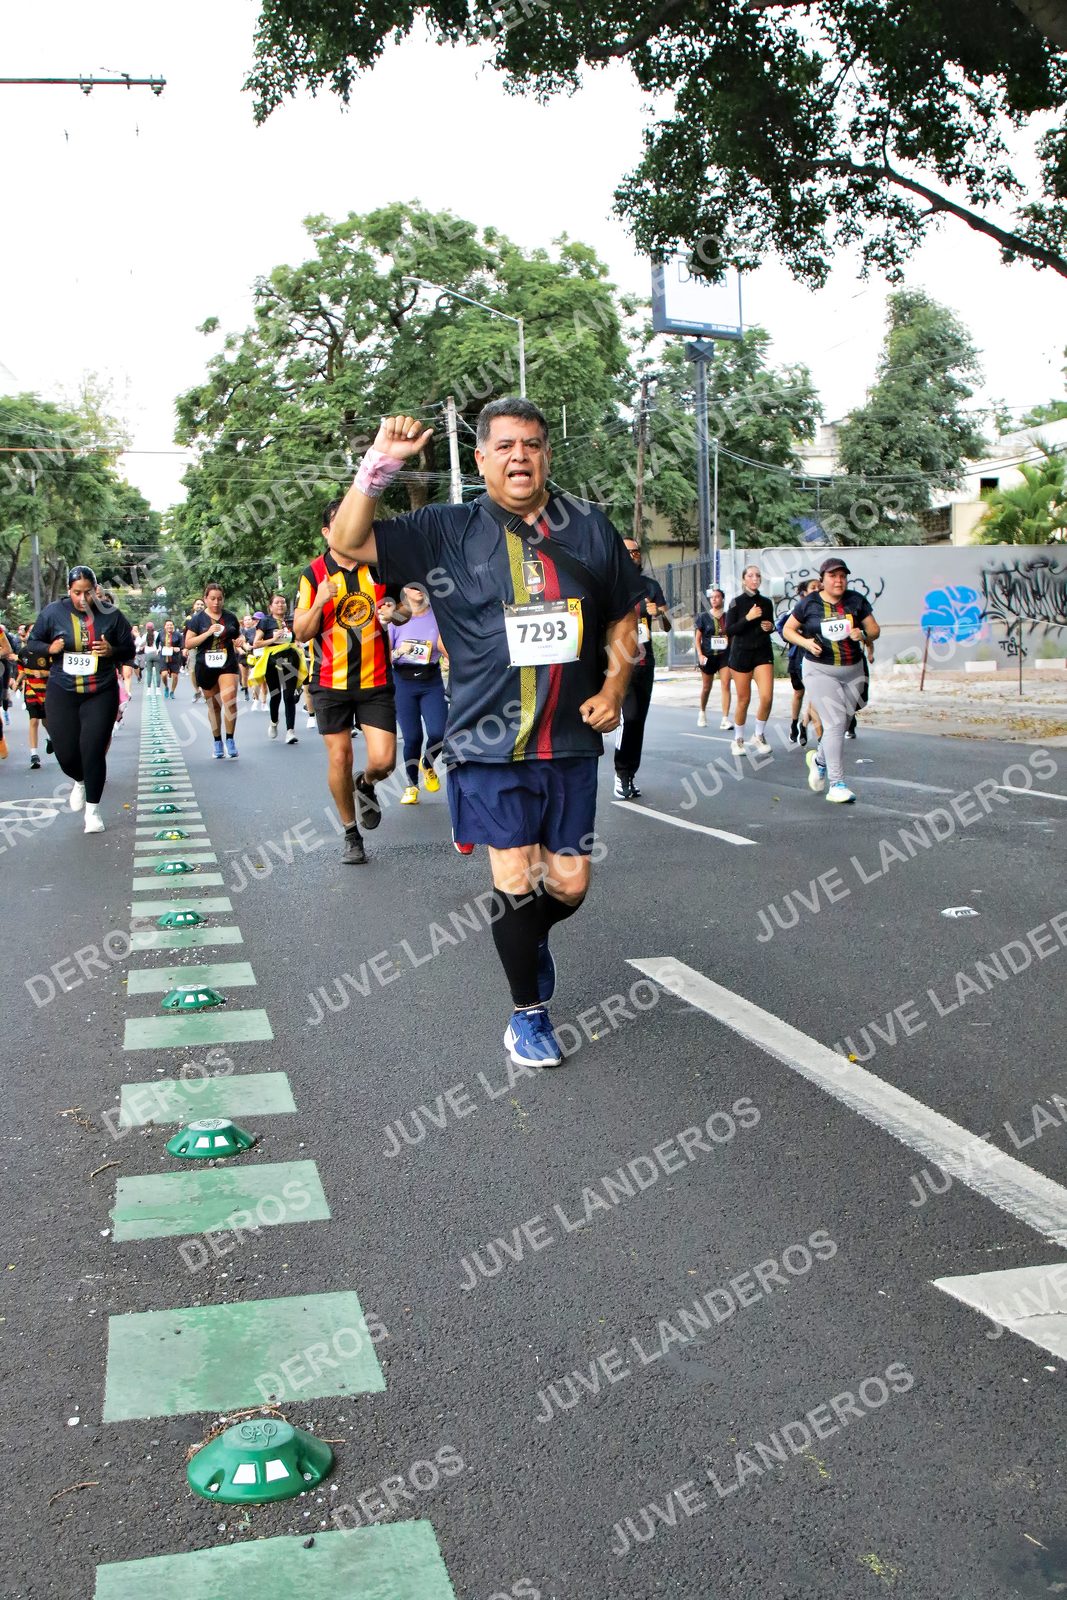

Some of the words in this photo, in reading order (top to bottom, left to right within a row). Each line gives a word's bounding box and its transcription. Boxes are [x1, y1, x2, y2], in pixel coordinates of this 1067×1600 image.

[516, 620, 568, 643] 7293
[828, 622, 845, 633] 459
[67, 656, 91, 667] 3939
